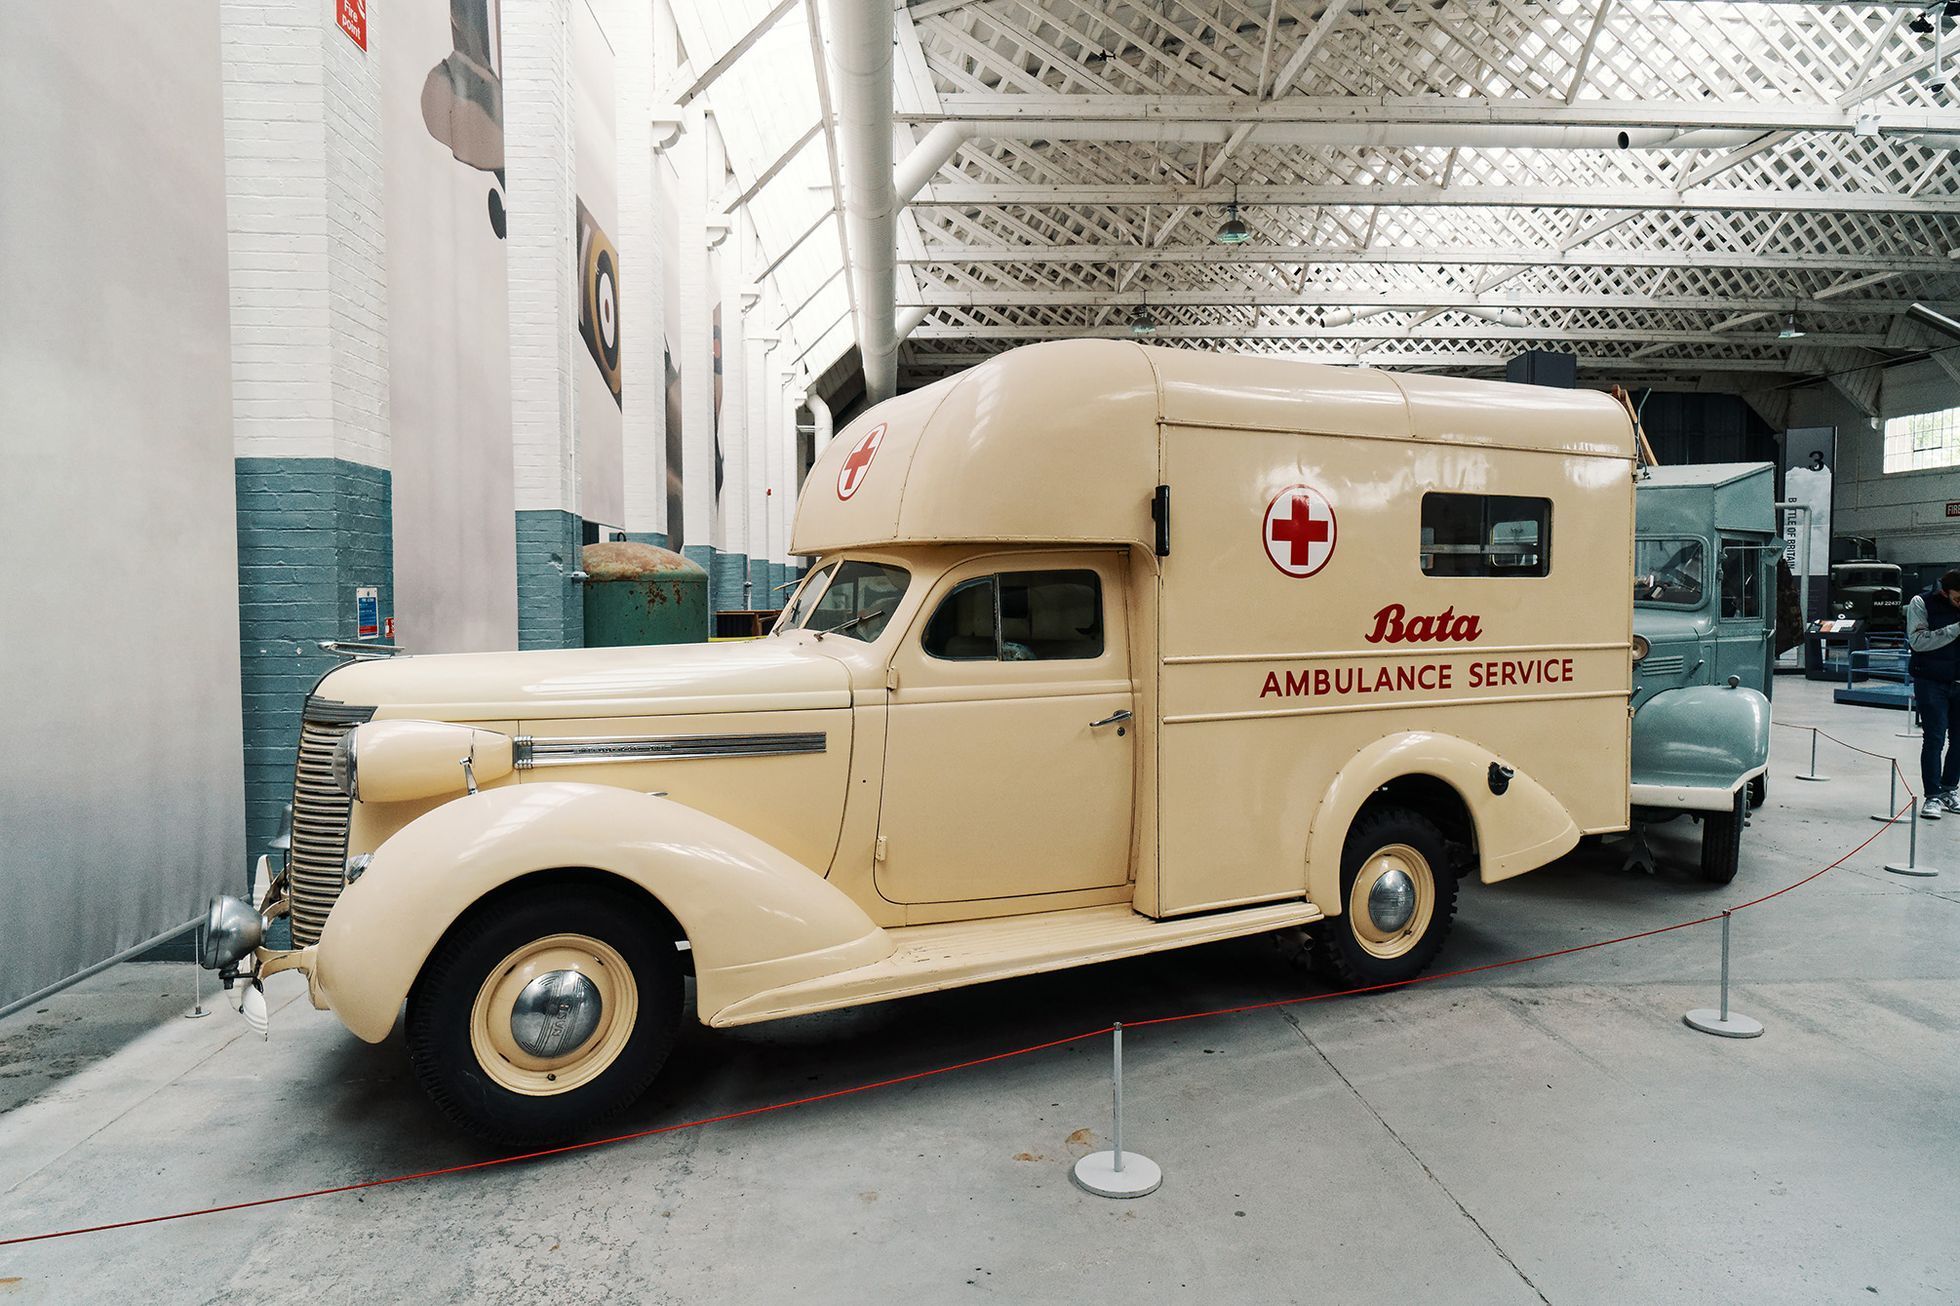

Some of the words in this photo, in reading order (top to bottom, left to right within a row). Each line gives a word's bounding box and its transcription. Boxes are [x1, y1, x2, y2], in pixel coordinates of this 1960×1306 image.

[1809, 450, 1824, 472] 3
[1787, 497, 1798, 526] BTTLE
[1787, 527, 1797, 538] OF
[1365, 603, 1483, 644] Bata
[1260, 664, 1452, 698] AMBULANCE
[1468, 658, 1574, 688] SERVICE
